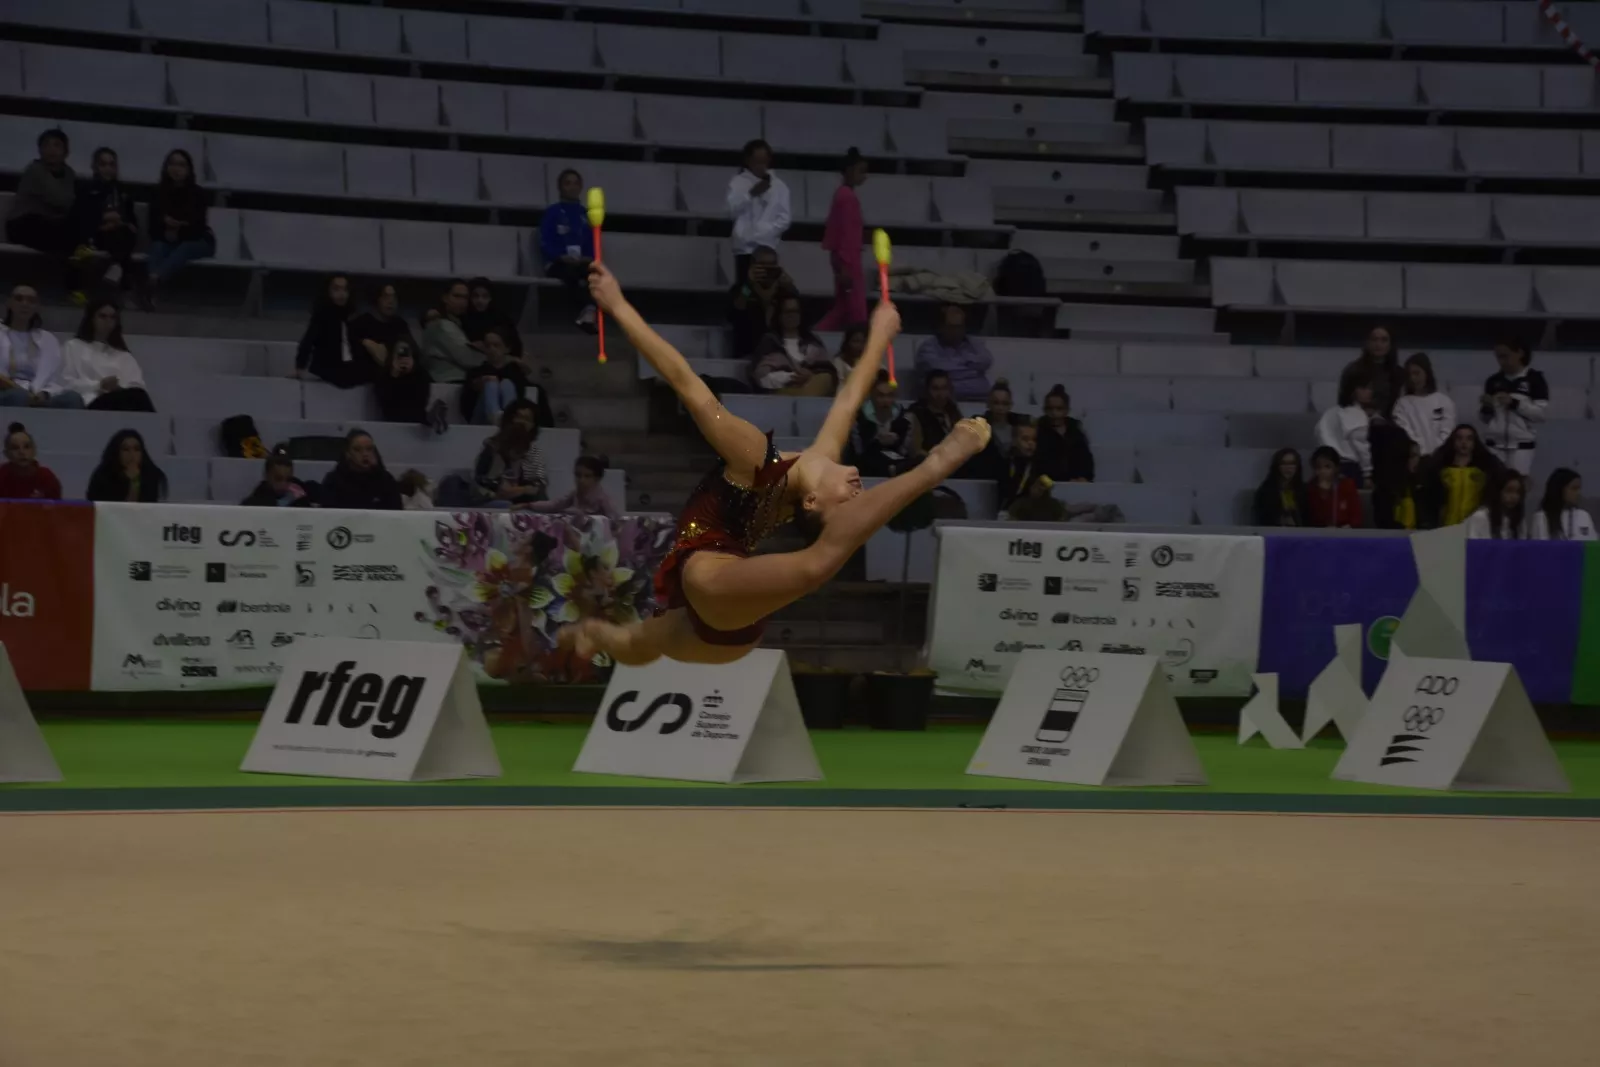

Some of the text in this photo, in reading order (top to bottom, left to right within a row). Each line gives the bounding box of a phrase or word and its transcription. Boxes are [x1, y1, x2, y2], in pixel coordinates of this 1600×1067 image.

[163, 523, 202, 544] rfeg
[1008, 538, 1043, 558] rfeg
[0, 582, 35, 617] la
[1415, 674, 1460, 696] ADO
[284, 660, 427, 739] rfeg
